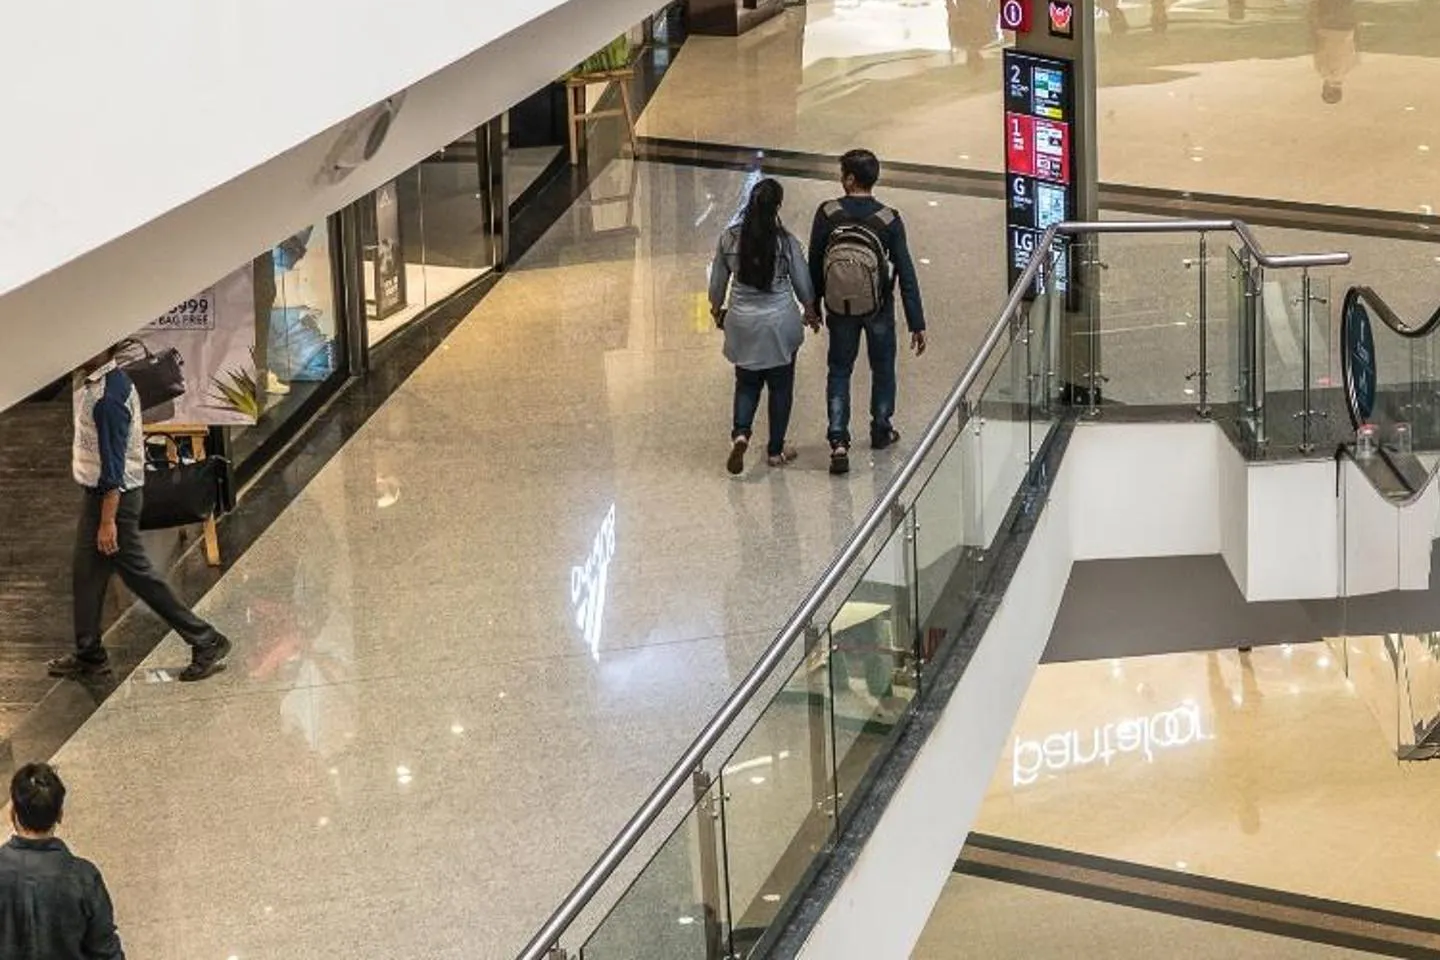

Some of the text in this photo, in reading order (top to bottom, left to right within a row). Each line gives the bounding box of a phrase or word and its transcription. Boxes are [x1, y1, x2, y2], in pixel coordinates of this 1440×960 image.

[1011, 64, 1021, 84] 2
[1013, 177, 1026, 195] G
[1014, 230, 1034, 253] LG
